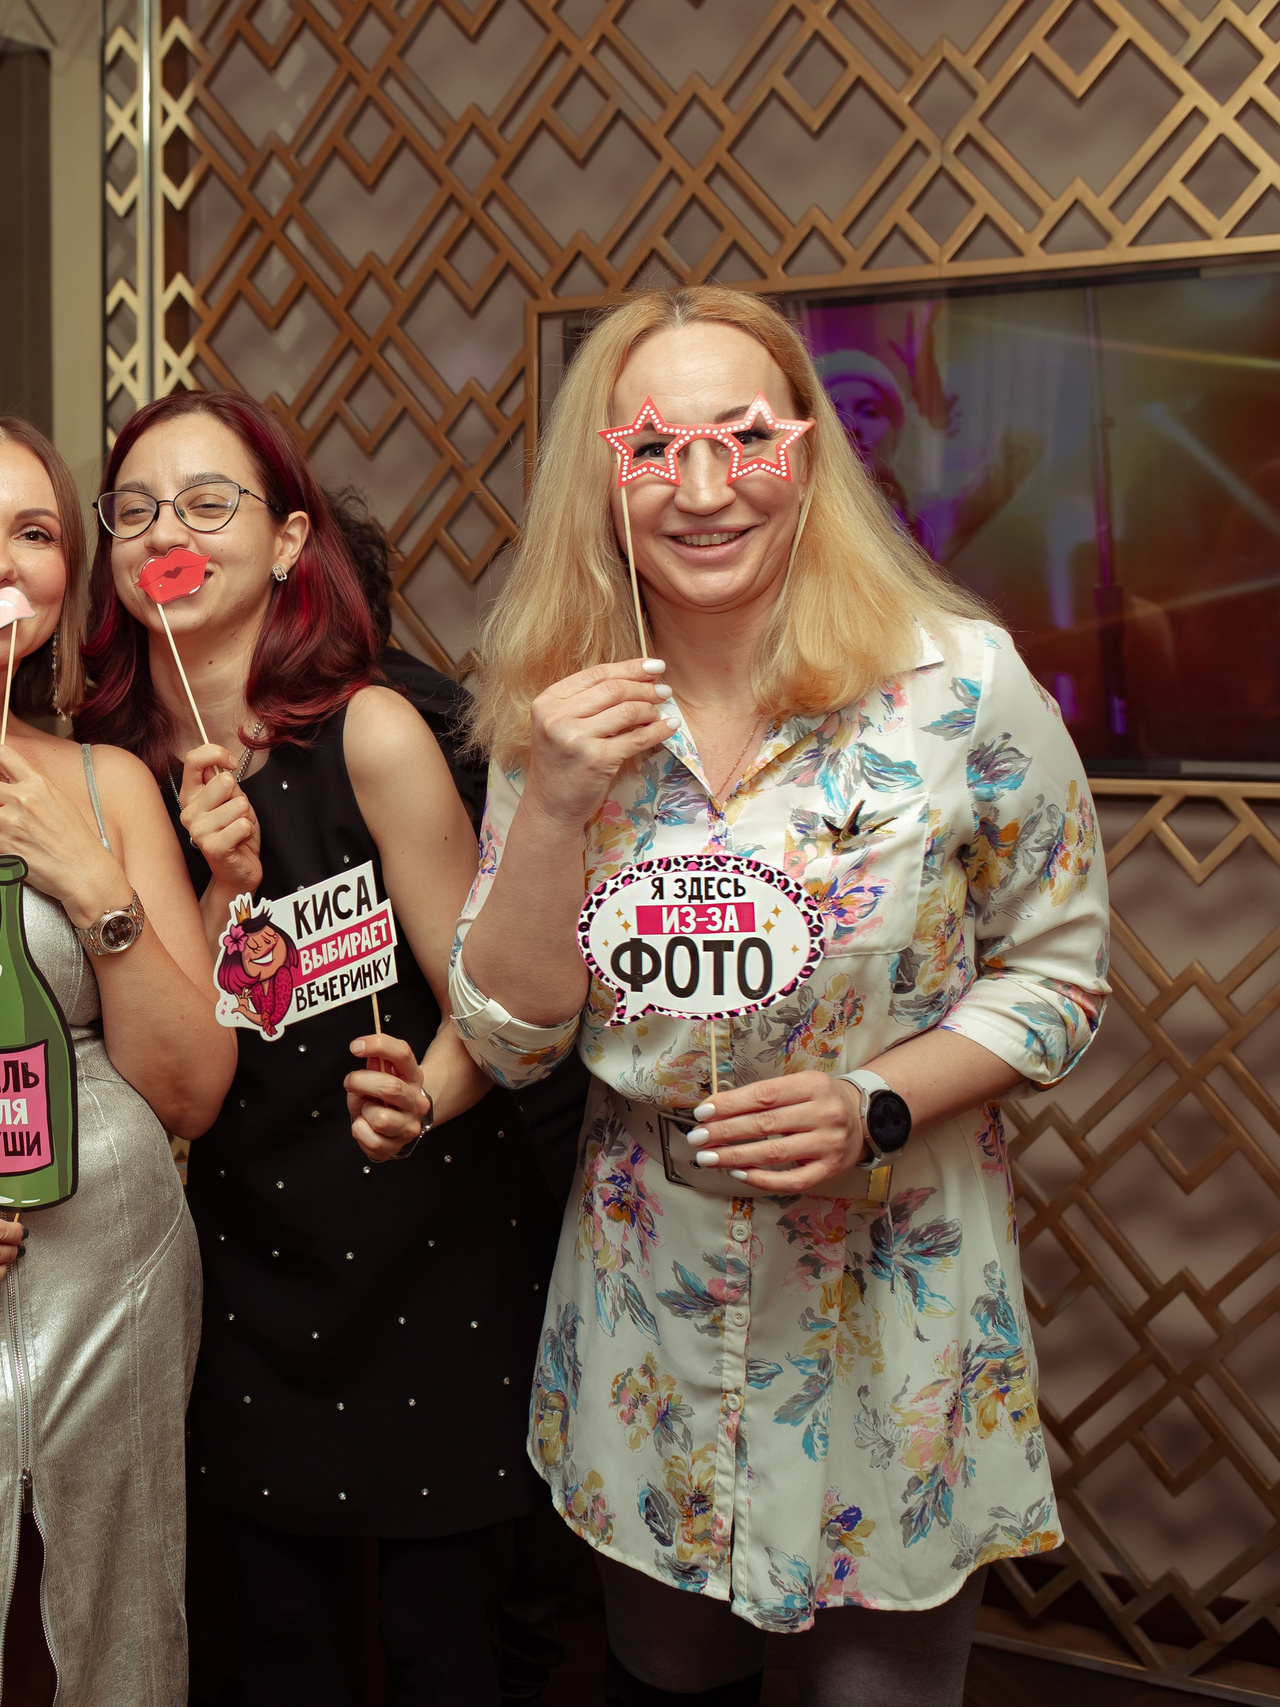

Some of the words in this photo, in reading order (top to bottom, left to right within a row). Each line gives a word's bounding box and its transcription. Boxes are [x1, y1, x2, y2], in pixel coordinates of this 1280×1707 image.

[292, 875, 373, 940] КИСА
[651, 877, 664, 900] Я
[673, 877, 746, 903] ЗДЕСЬ
[662, 904, 740, 933] ИЗ-ЗА
[299, 918, 388, 976] ВЫБИРАЕТ
[610, 935, 773, 1001] ФОТО
[295, 954, 392, 1013] ВЕЧЕРИНКУ
